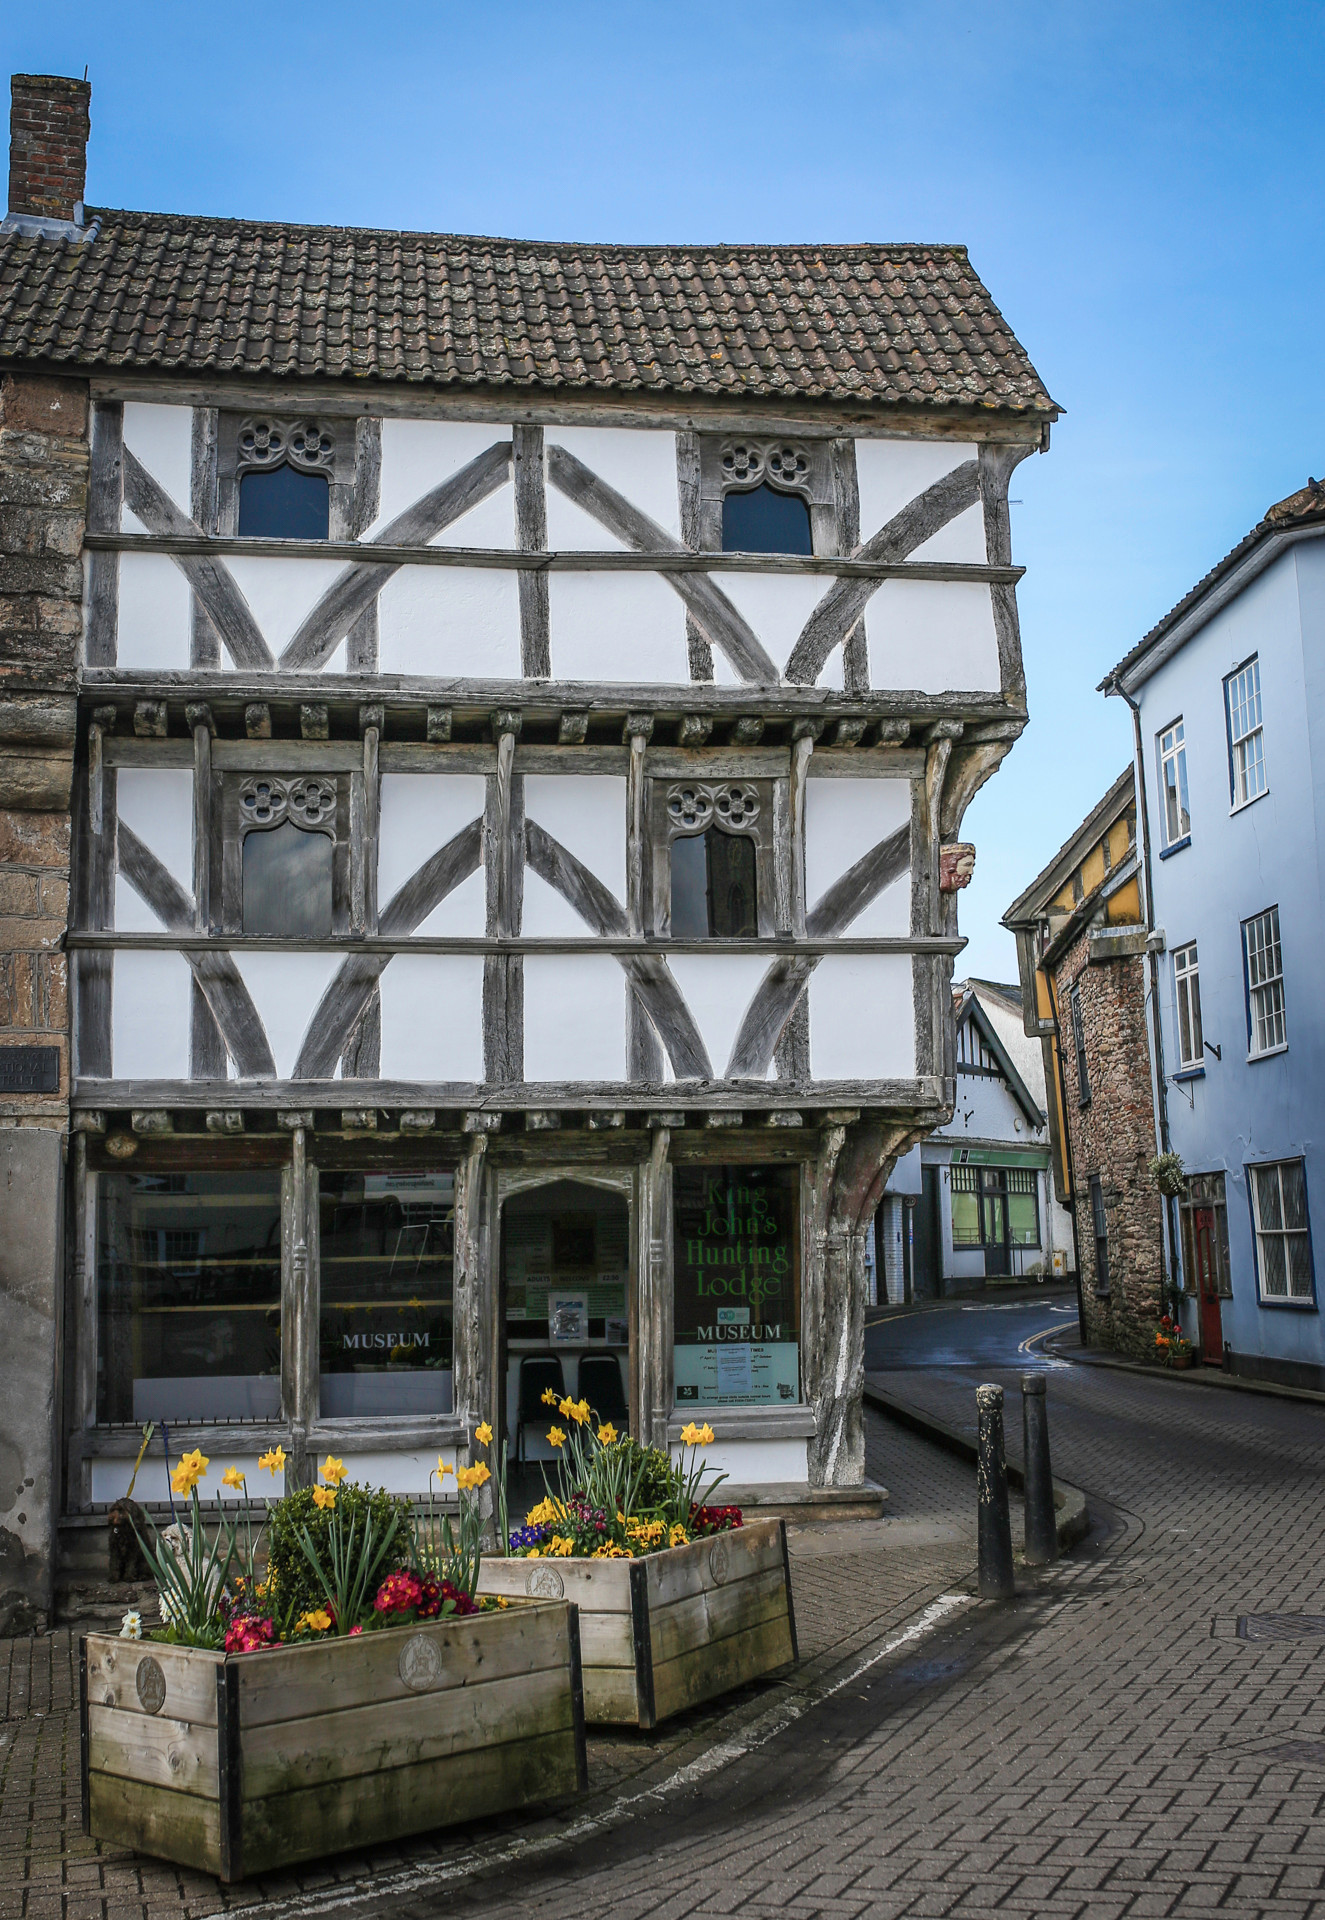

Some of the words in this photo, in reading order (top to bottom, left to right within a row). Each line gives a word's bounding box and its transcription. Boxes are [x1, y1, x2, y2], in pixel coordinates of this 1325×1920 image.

[708, 1179, 769, 1215] King
[697, 1206, 778, 1236] John's
[687, 1240, 789, 1274] Hunting
[526, 1275, 551, 1283] ADULTS
[696, 1268, 781, 1305] Lodge
[342, 1332, 431, 1349] MUSEUM
[696, 1324, 781, 1341] MUSEUM
